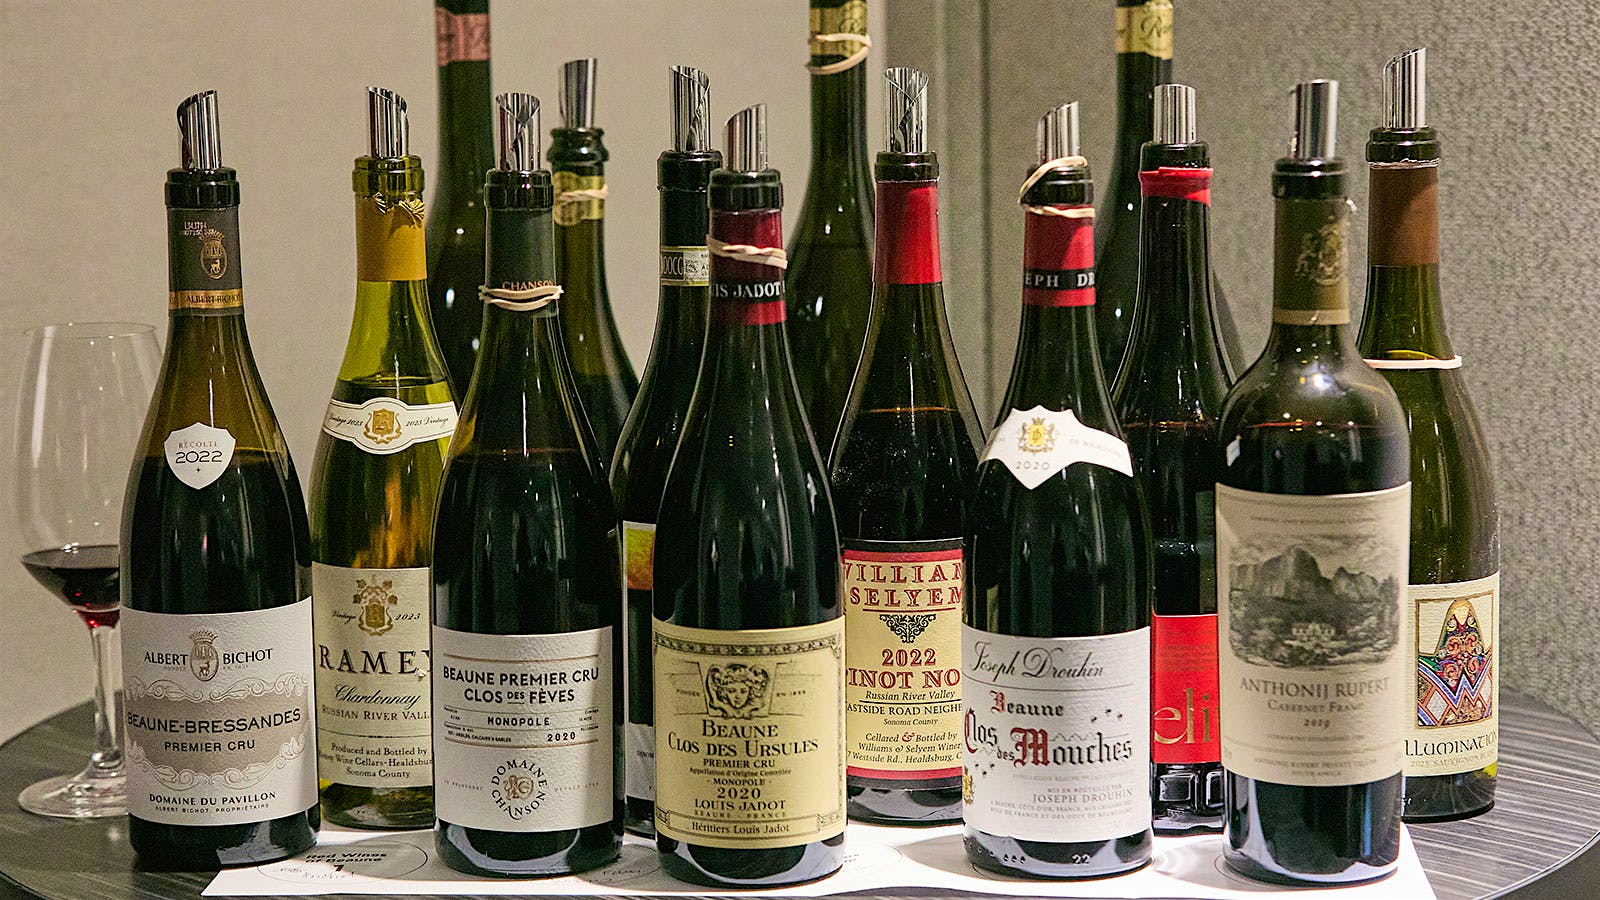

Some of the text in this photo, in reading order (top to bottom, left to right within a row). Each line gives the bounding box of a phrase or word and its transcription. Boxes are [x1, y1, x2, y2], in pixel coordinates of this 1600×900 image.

[712, 281, 782, 298] IS JADOT
[175, 450, 223, 464] 2022
[144, 648, 273, 666] ALBERT BICHOT
[882, 648, 936, 667] 2022
[969, 640, 1105, 682] Joseph Drouhin
[443, 666, 600, 687] BEAUNE PREMIER CRU
[846, 668, 914, 690] INOT
[866, 689, 956, 701] Russian River Valley
[1240, 676, 1390, 700] ANTHONIJ RUPERT
[334, 683, 422, 710] Chardonnay
[464, 688, 575, 704] CLOS DES FÈVES
[363, 710, 398, 720] RIVER
[402, 711, 430, 720] VALL
[846, 703, 886, 714] ASTSIDE
[888, 707, 921, 716] ROAD
[1154, 688, 1218, 744] eli
[127, 708, 302, 734] BEAUNE-BRESSANDES
[487, 716, 550, 726] MONOPOLE
[883, 718, 939, 727] Sonoma County
[702, 718, 779, 739] BEAUNE
[547, 732, 576, 742] 2020
[865, 732, 958, 742] Cellared & Bottled by
[164, 740, 256, 752] PREMIER CRU
[331, 742, 428, 757] Produced and Bottled by
[668, 731, 819, 758] CLOS DES URSULES
[858, 742, 893, 752] Williams
[906, 744, 936, 754] Selyem
[1010, 727, 1132, 768] Mouches
[703, 758, 776, 768] PREMIER CRU
[852, 751, 884, 763] Westside
[346, 767, 411, 779] Sonoma County
[491, 759, 548, 788] DOMAINE
[712, 778, 766, 786] MONOPOLE
[149, 792, 277, 806] DOMAINE DU PAVILLON
[716, 787, 762, 800] 2020
[1032, 788, 1134, 804] JOSEPH DROUHIN
[491, 789, 547, 821] CHANSON
[694, 798, 787, 812] LOUIS JADOT
[692, 821, 790, 834] Héritiers Louis Jadot
